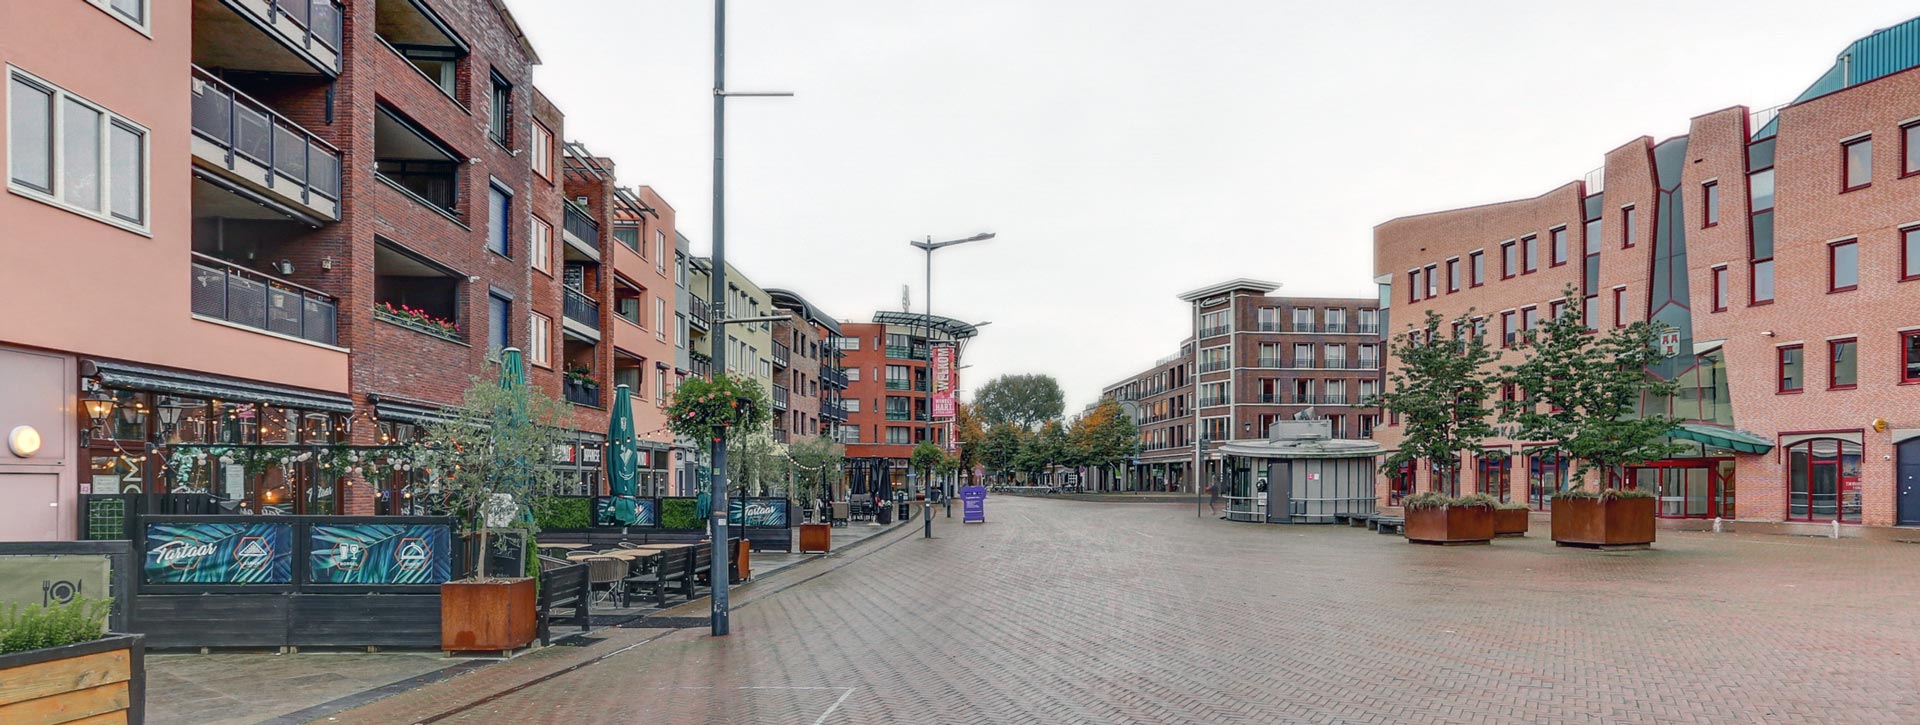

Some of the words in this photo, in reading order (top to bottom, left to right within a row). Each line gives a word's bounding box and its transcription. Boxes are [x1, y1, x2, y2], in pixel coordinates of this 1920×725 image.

[937, 345, 950, 391] WELKOM
[935, 403, 953, 411] HART
[152, 540, 218, 564] Tartaar
